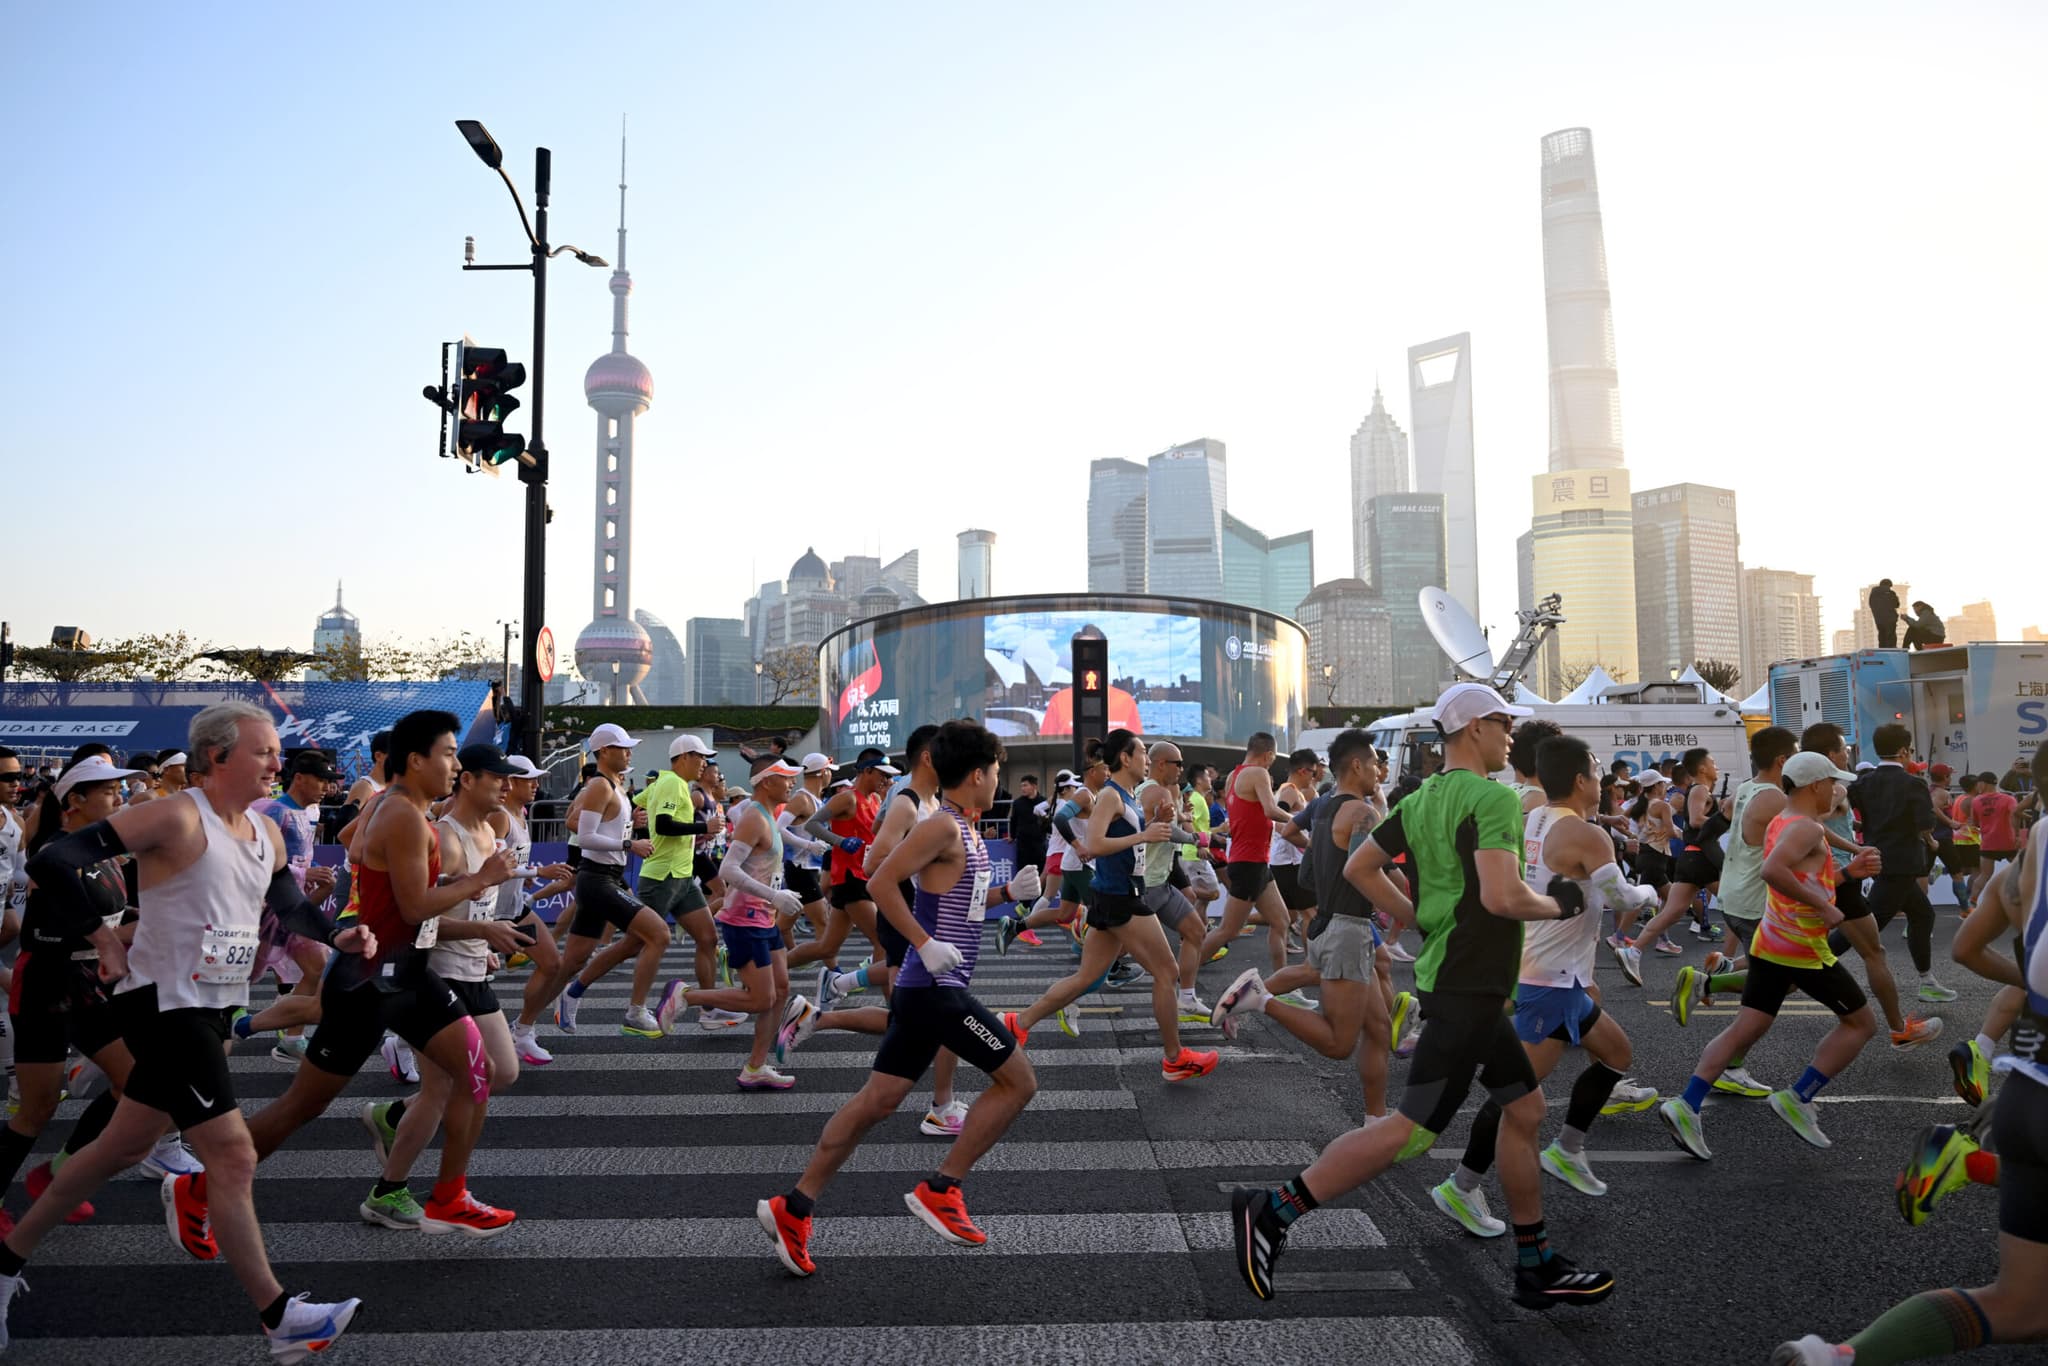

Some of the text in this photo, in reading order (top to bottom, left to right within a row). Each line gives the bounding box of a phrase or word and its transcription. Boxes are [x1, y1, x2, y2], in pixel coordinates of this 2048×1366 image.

[2015, 681, 2048, 697] 上海
[71, 724, 128, 733] RACE
[877, 731, 891, 747] big
[1612, 733, 1698, 747] 上海广播电视台
[226, 945, 253, 965] 829
[963, 1014, 1006, 1052] ADIZERO
